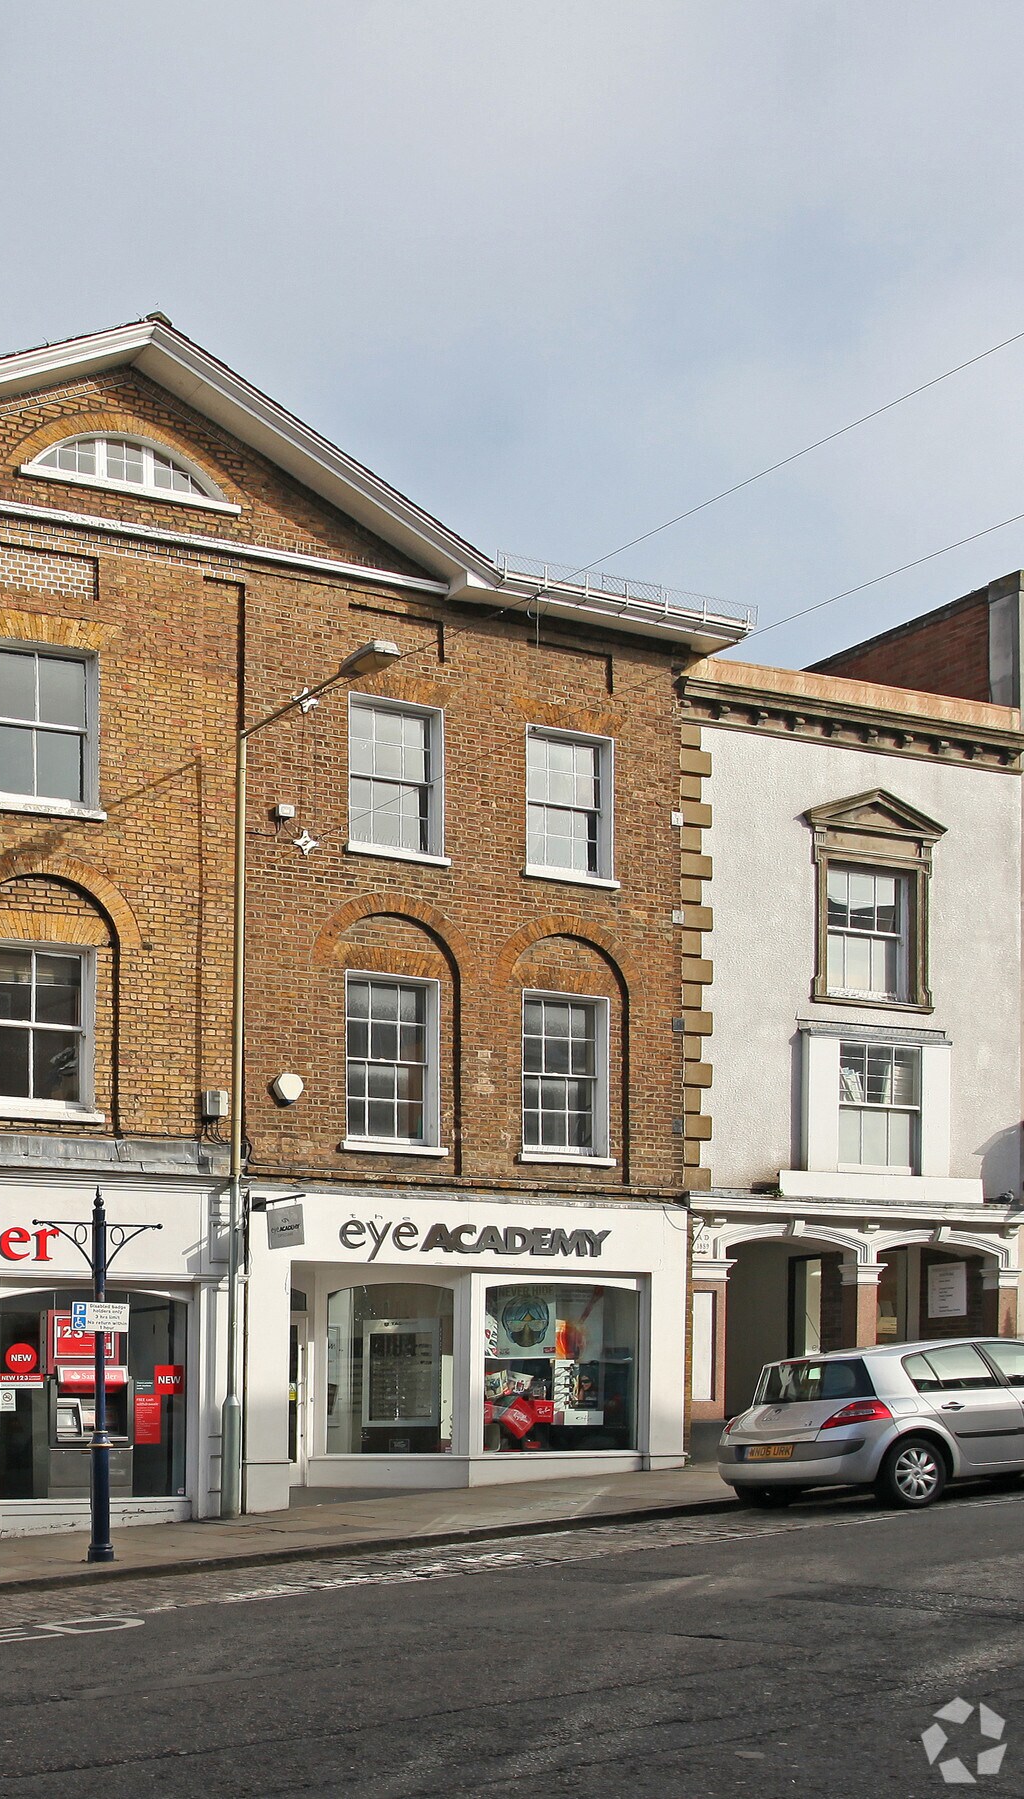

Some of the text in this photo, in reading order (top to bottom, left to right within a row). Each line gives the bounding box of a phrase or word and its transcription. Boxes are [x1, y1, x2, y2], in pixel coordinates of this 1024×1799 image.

[76, 1304, 85, 1315] P
[10, 1354, 32, 1362] NEW
[157, 1375, 181, 1384] NEW
[773, 1446, 791, 1456] URK
